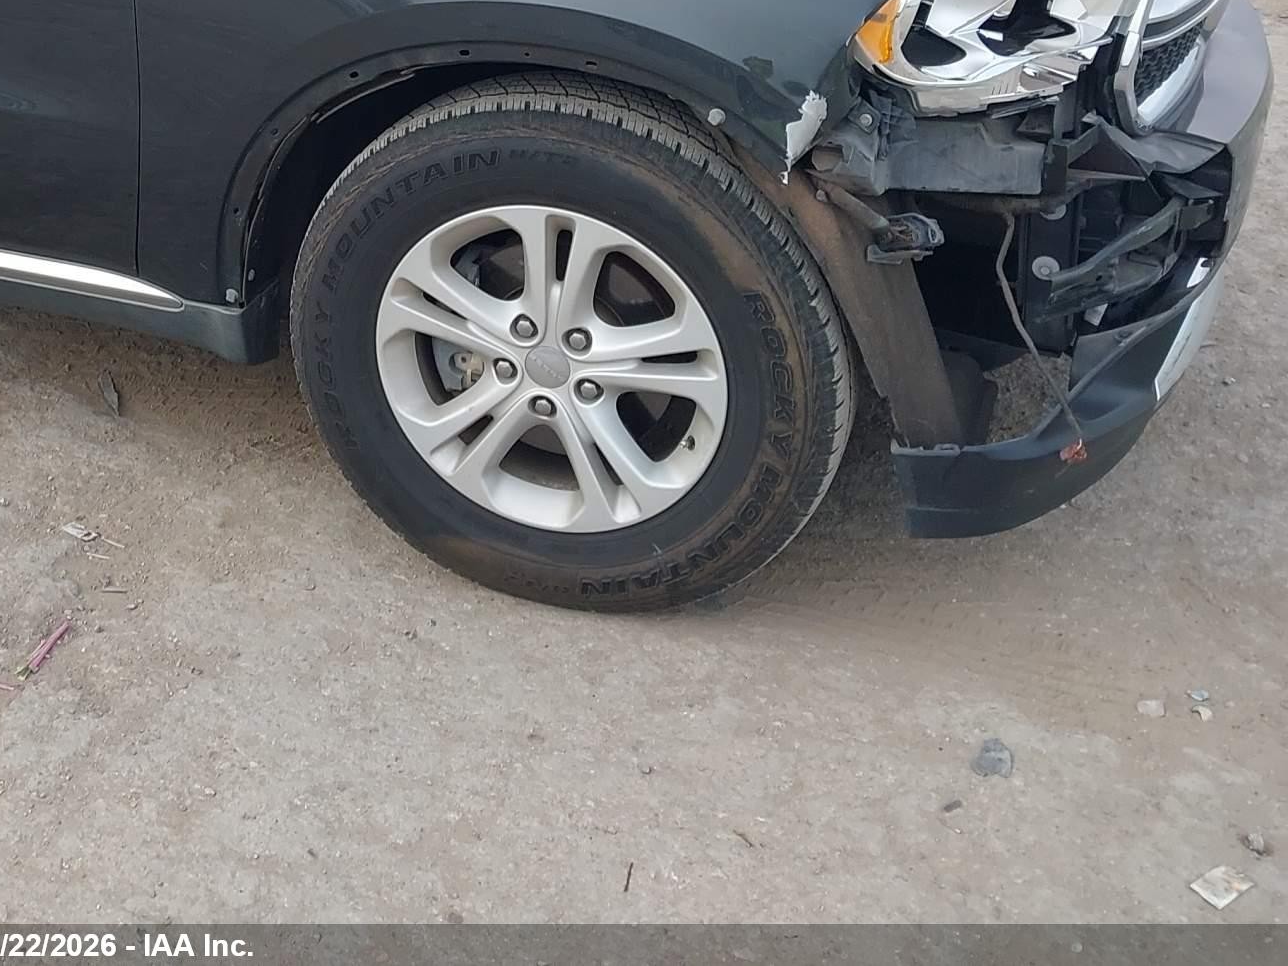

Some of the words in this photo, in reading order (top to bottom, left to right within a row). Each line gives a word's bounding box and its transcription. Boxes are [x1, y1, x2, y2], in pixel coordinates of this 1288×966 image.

[322, 148, 503, 292] MOUNTAIN
[742, 291, 797, 464] ROCKY
[579, 463, 783, 598] MOUNTAIN
